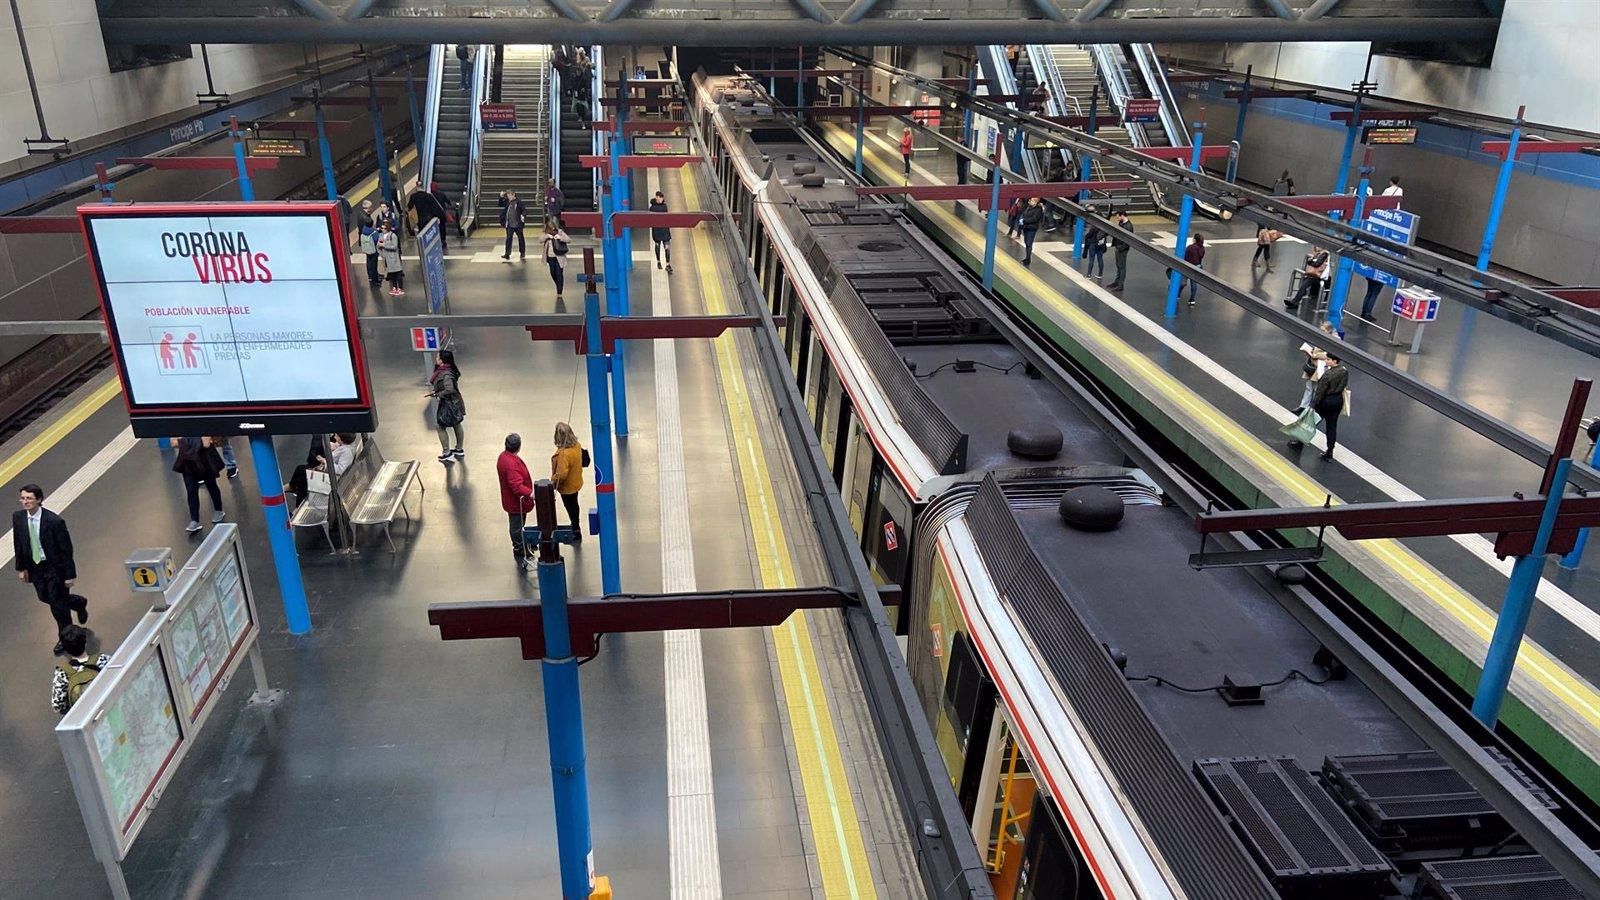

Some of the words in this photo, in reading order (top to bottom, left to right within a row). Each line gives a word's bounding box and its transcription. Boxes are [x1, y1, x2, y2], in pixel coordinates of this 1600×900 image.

[161, 231, 252, 258] CORONA
[192, 252, 272, 284] VIRUS
[145, 306, 193, 316] POBLACIÓN
[194, 306, 250, 315] VULNERABLE
[272, 331, 313, 340] MAYORES
[243, 341, 312, 351] ENFERMEDADES
[214, 352, 251, 361] PREVAS
